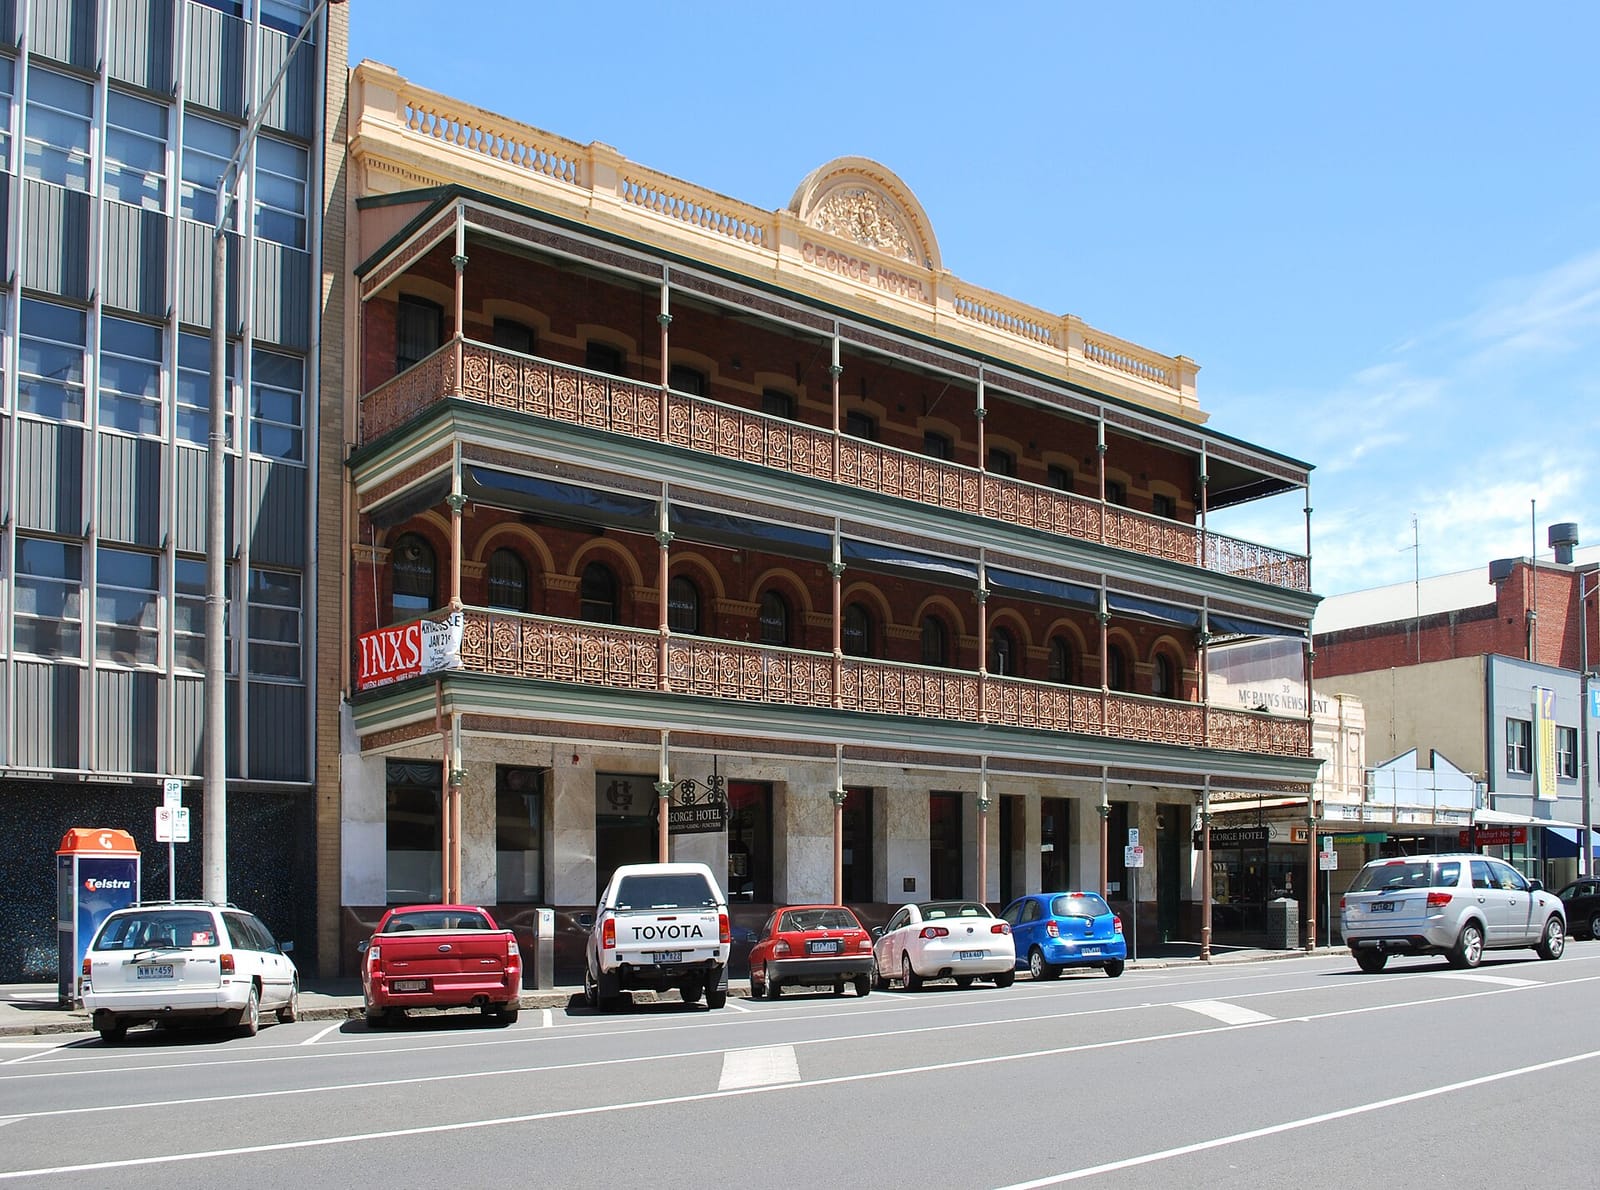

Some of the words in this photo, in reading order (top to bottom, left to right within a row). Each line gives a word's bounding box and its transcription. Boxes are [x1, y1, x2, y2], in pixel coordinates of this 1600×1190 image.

[802, 241, 871, 284] GEORGE
[876, 267, 928, 303] HOTEL
[360, 625, 420, 678] INXS
[1282, 684, 1290, 693] 35
[166, 782, 180, 792] 3P
[176, 810, 187, 819] 1P
[696, 809, 721, 820] HOTEL
[1238, 831, 1265, 840] HOTEL
[85, 879, 131, 890] Telstra
[631, 925, 703, 940] TOYOTA
